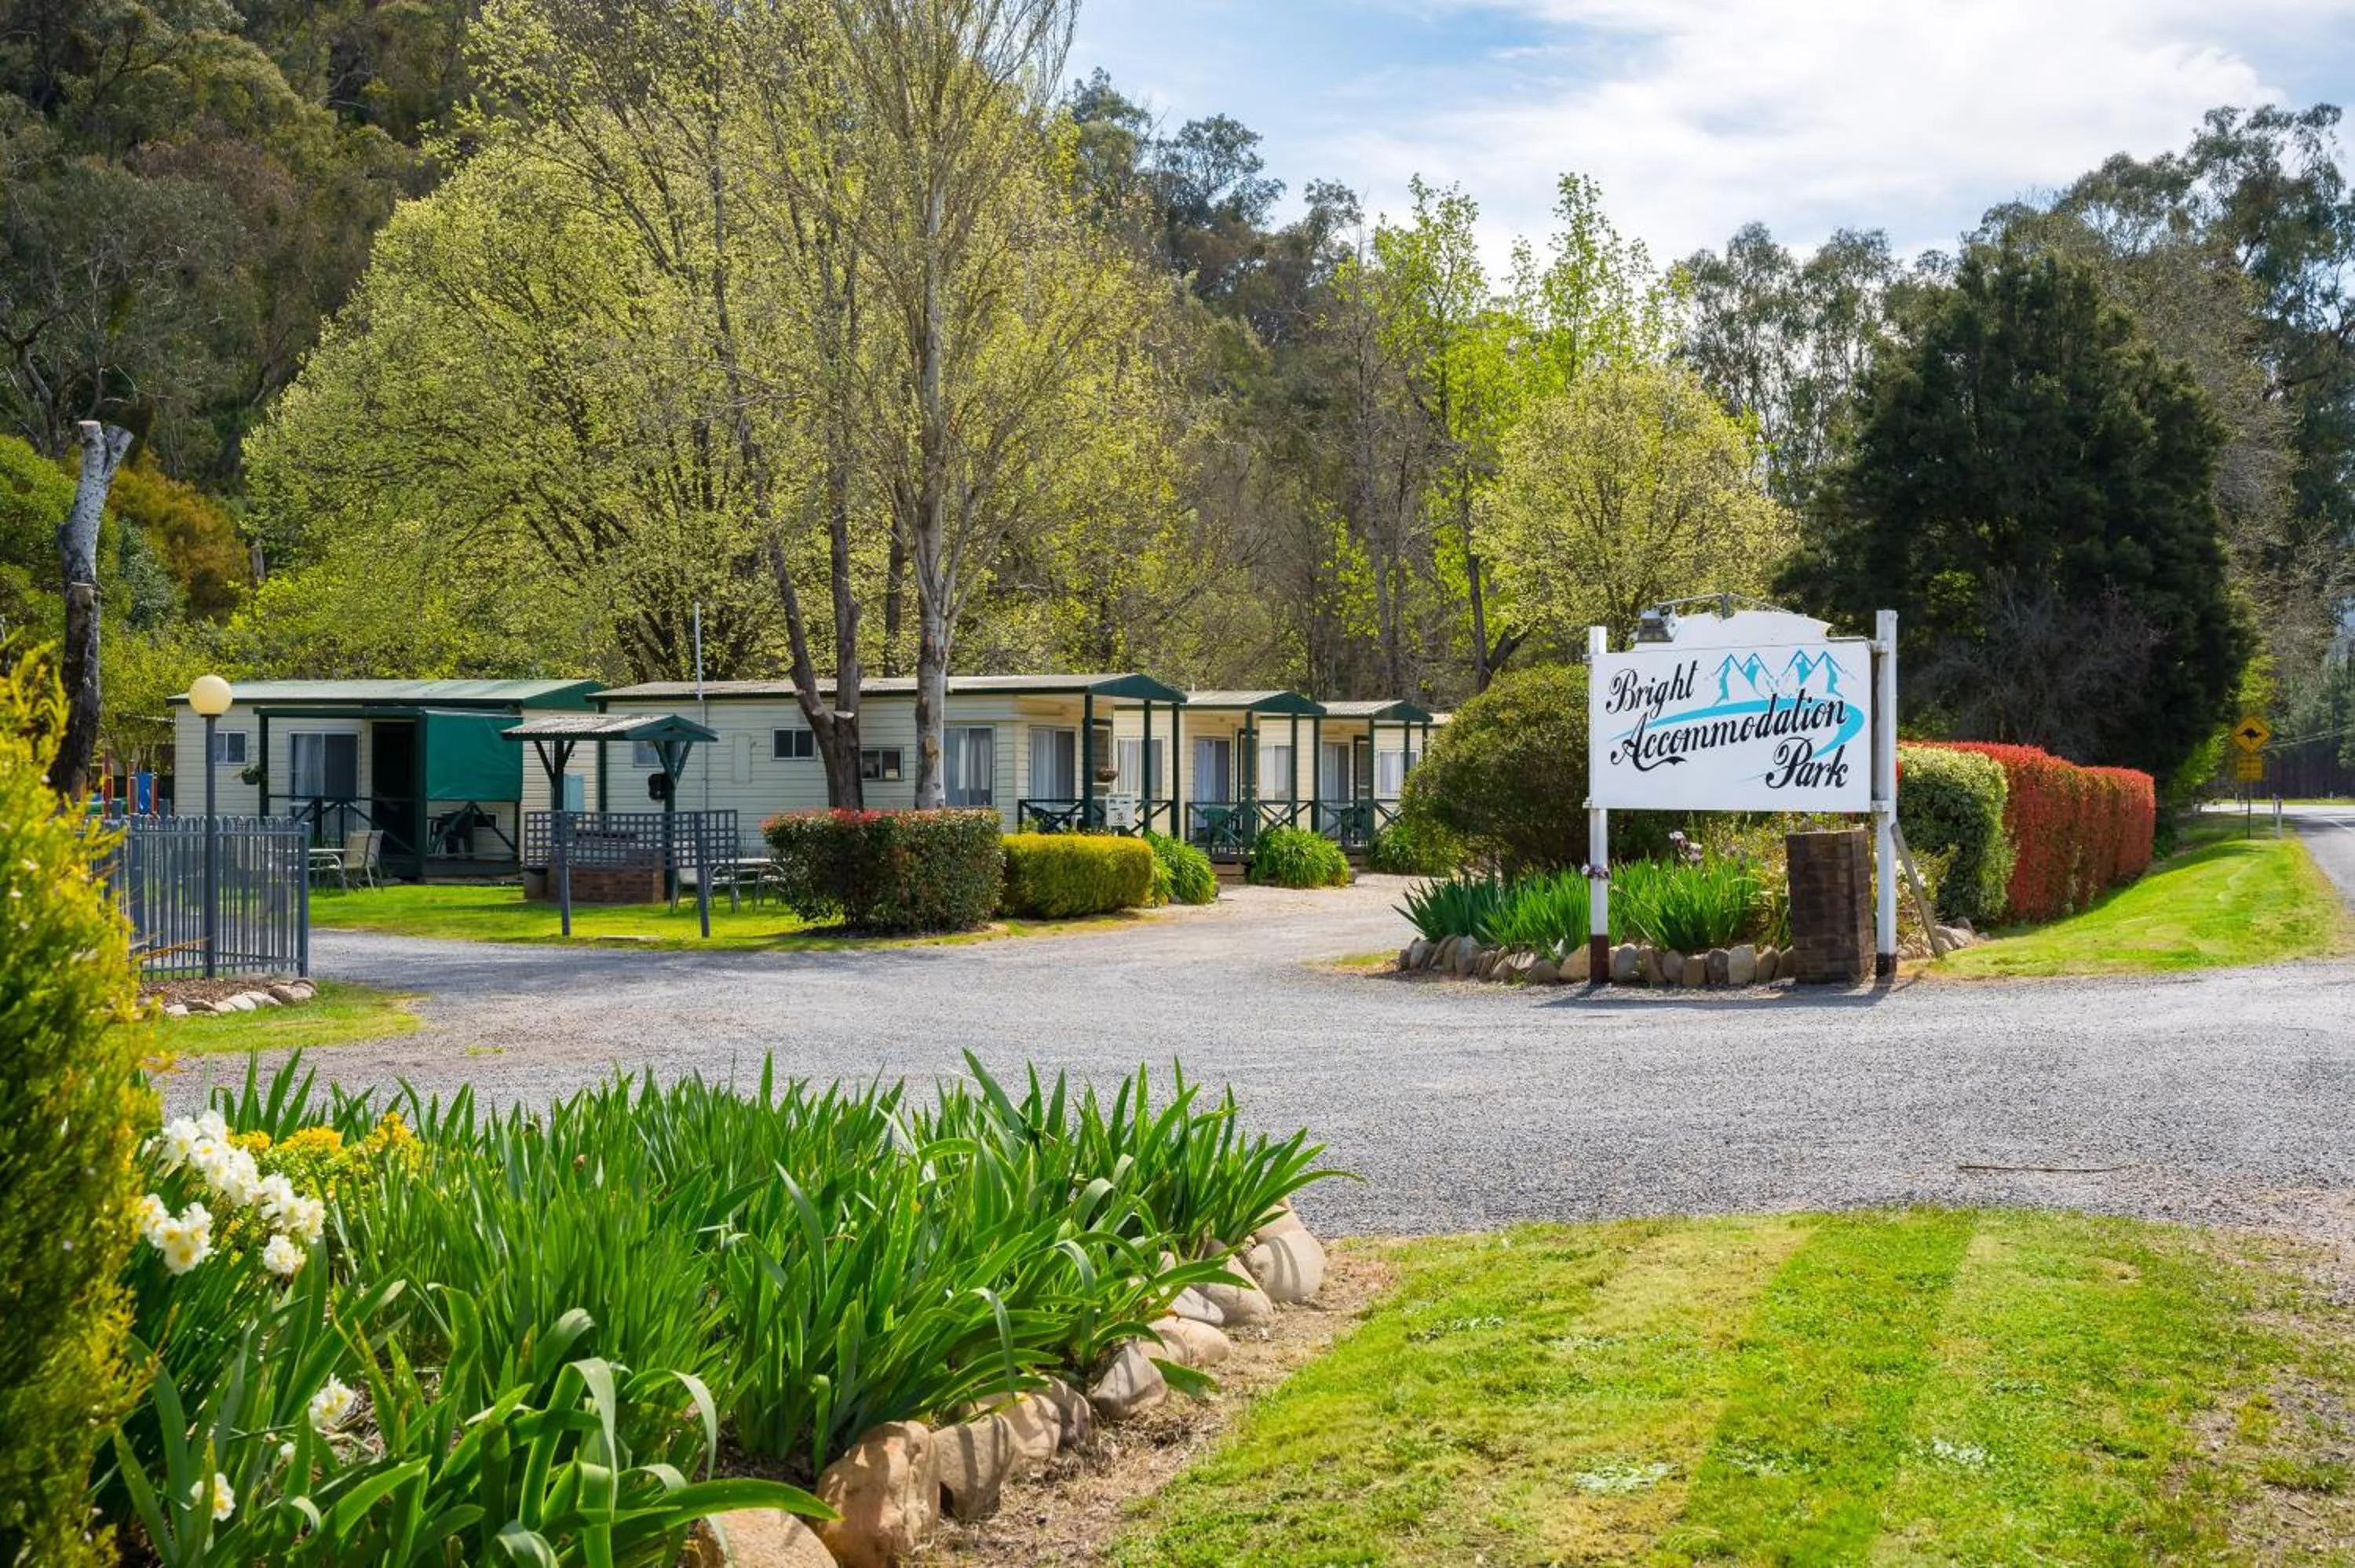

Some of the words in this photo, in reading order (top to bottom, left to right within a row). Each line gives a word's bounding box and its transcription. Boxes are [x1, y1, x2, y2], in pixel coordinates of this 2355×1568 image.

[1605, 659, 1698, 719] Bright
[1610, 687, 1847, 772] Accommodation
[1765, 737, 1849, 789] Park
